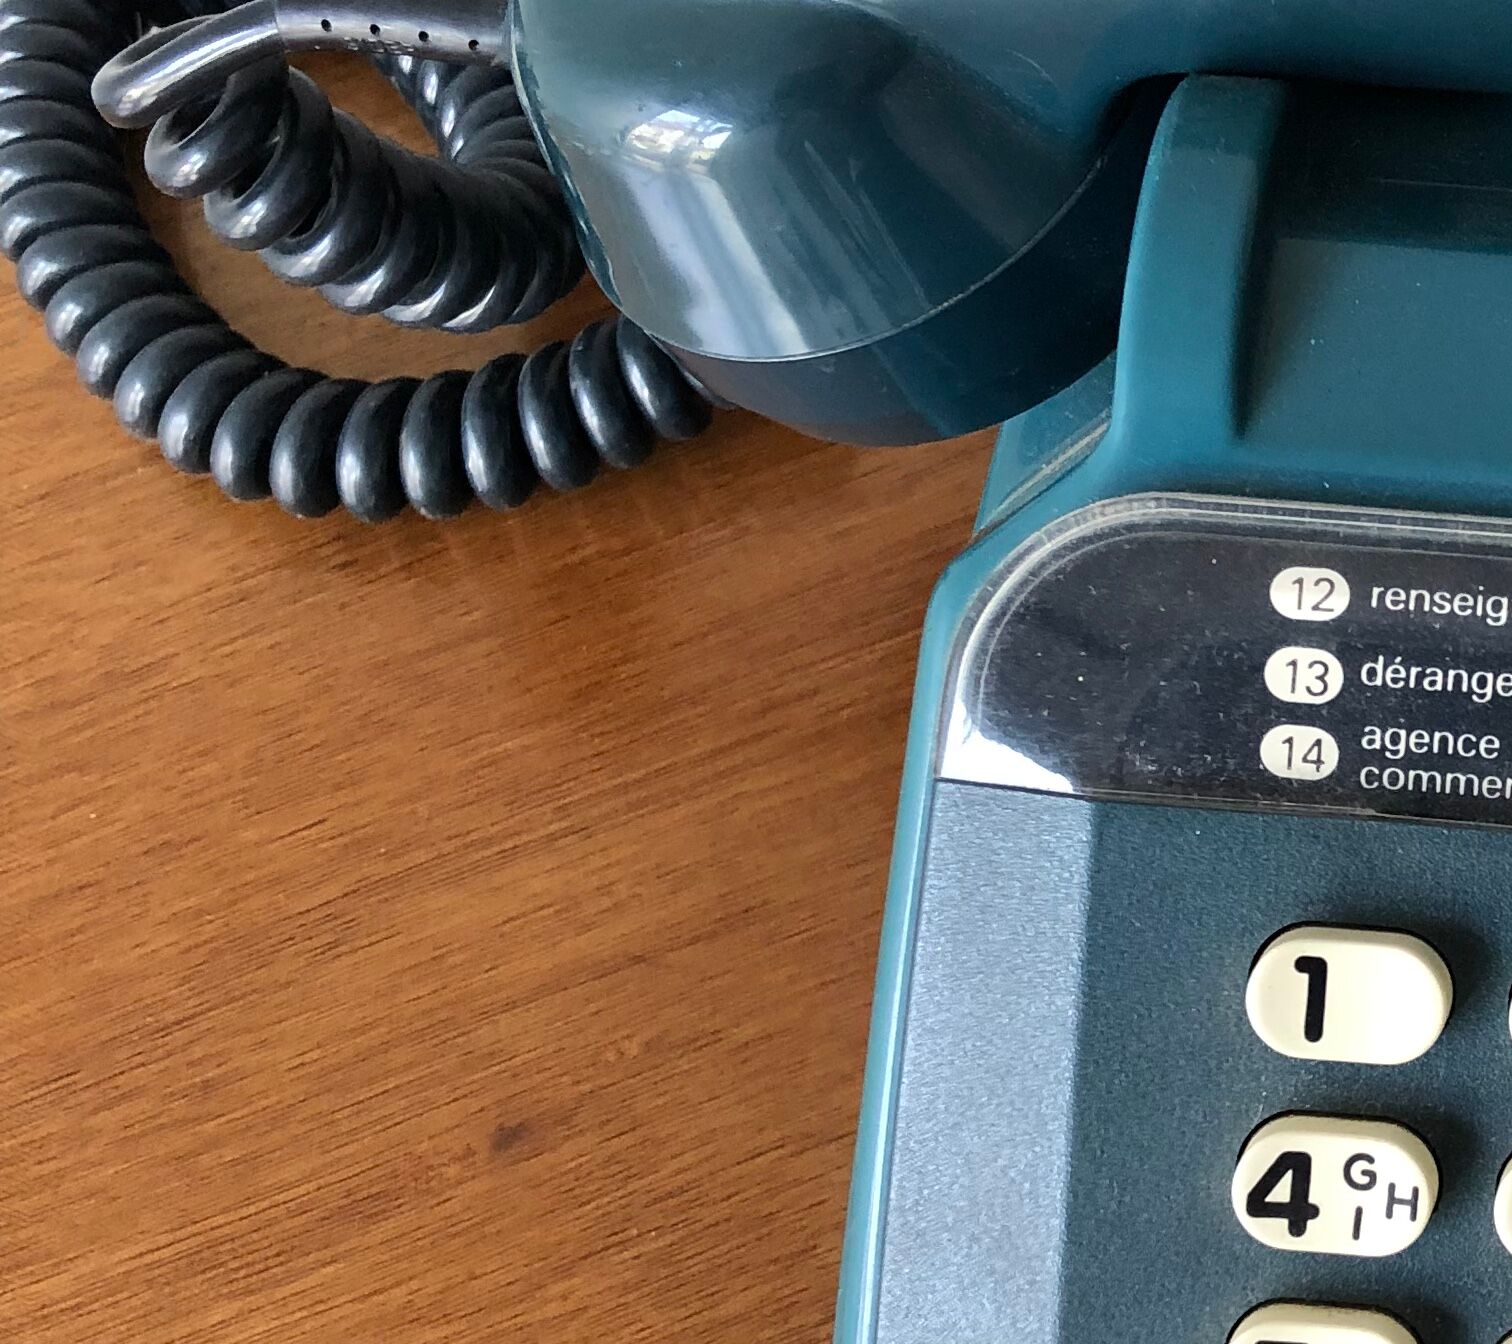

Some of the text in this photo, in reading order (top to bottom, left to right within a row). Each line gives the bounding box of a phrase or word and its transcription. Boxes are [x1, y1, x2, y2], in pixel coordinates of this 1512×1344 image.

[1292, 577, 1336, 613] 12
[1285, 658, 1330, 697] 13
[1281, 724, 1500, 773] 14 agence
[1294, 956, 1327, 1042] 1
[1246, 1151, 1319, 1237] 4
